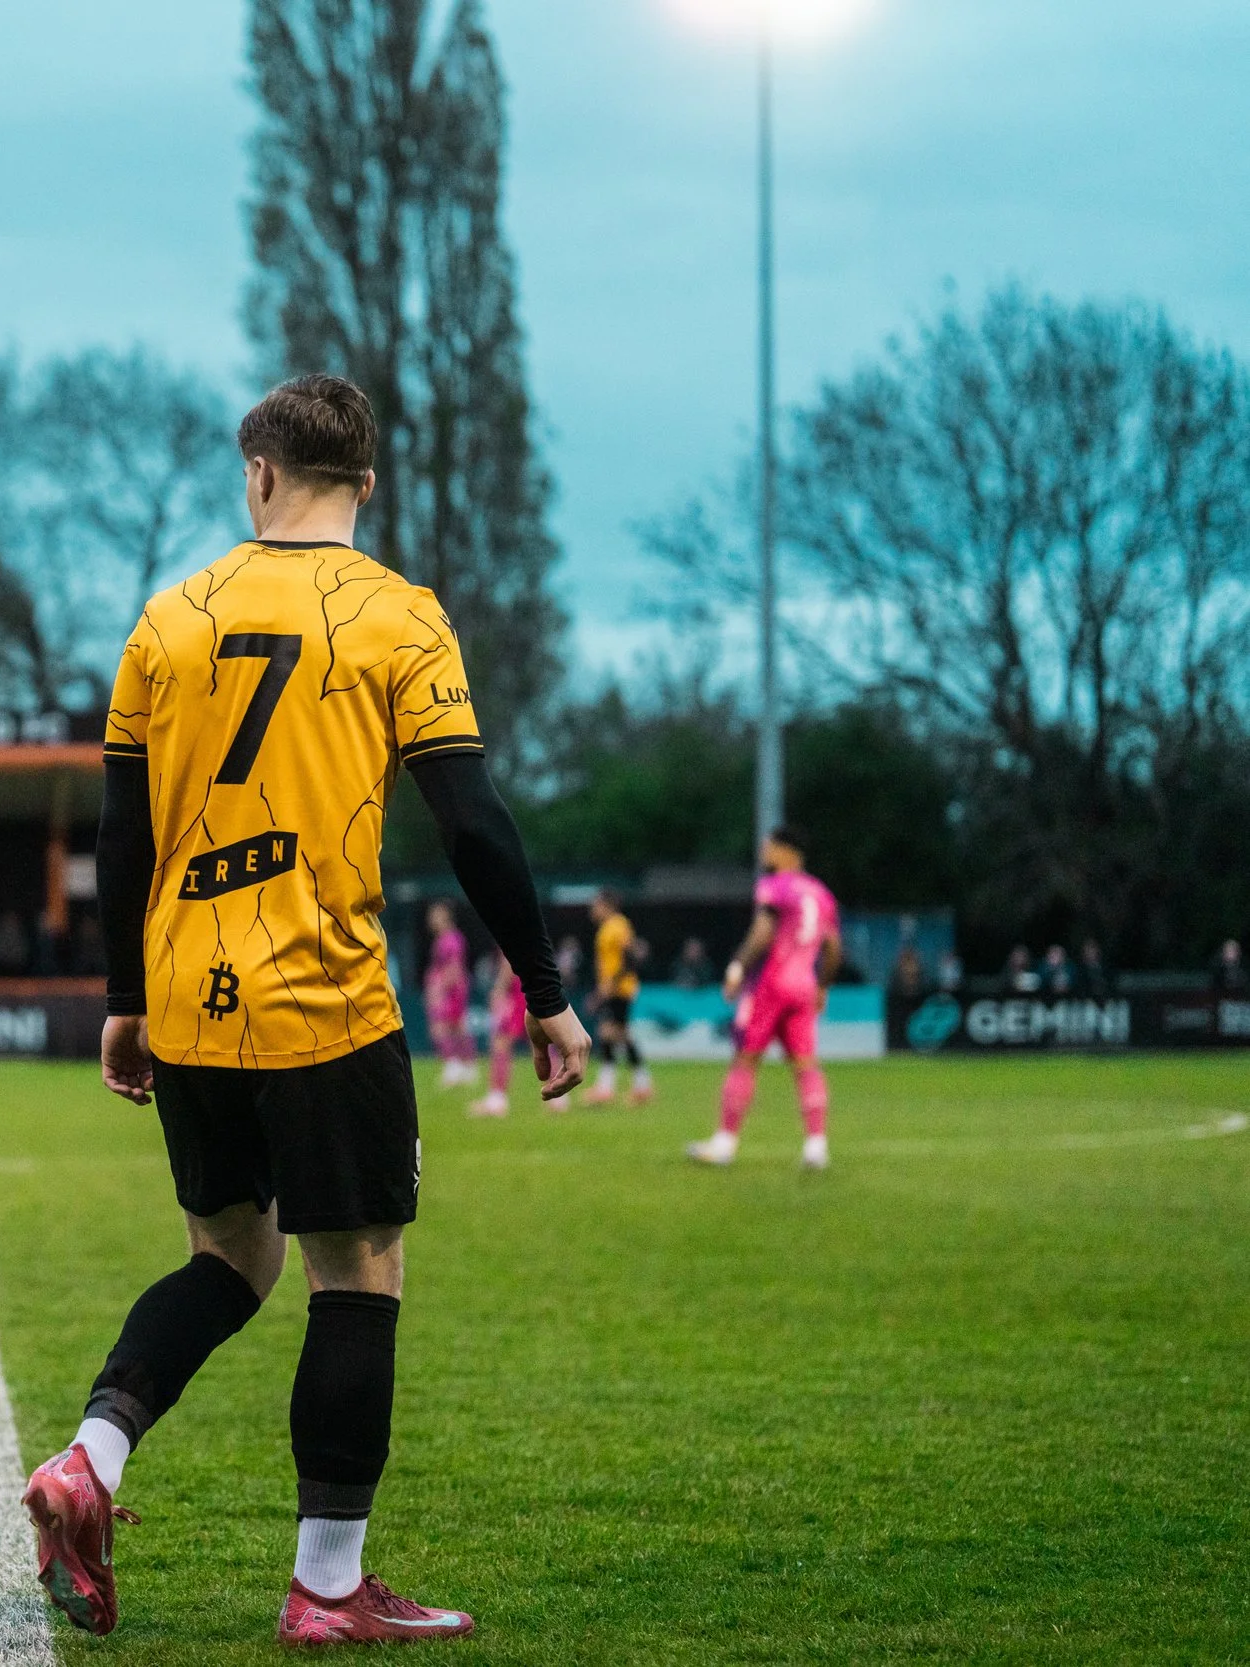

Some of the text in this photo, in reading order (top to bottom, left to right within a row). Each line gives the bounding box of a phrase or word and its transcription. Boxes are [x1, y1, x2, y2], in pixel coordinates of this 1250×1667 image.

[213, 633, 302, 784] 7
[185, 839, 284, 892] IREN
[966, 1000, 1130, 1043] GEMINI
